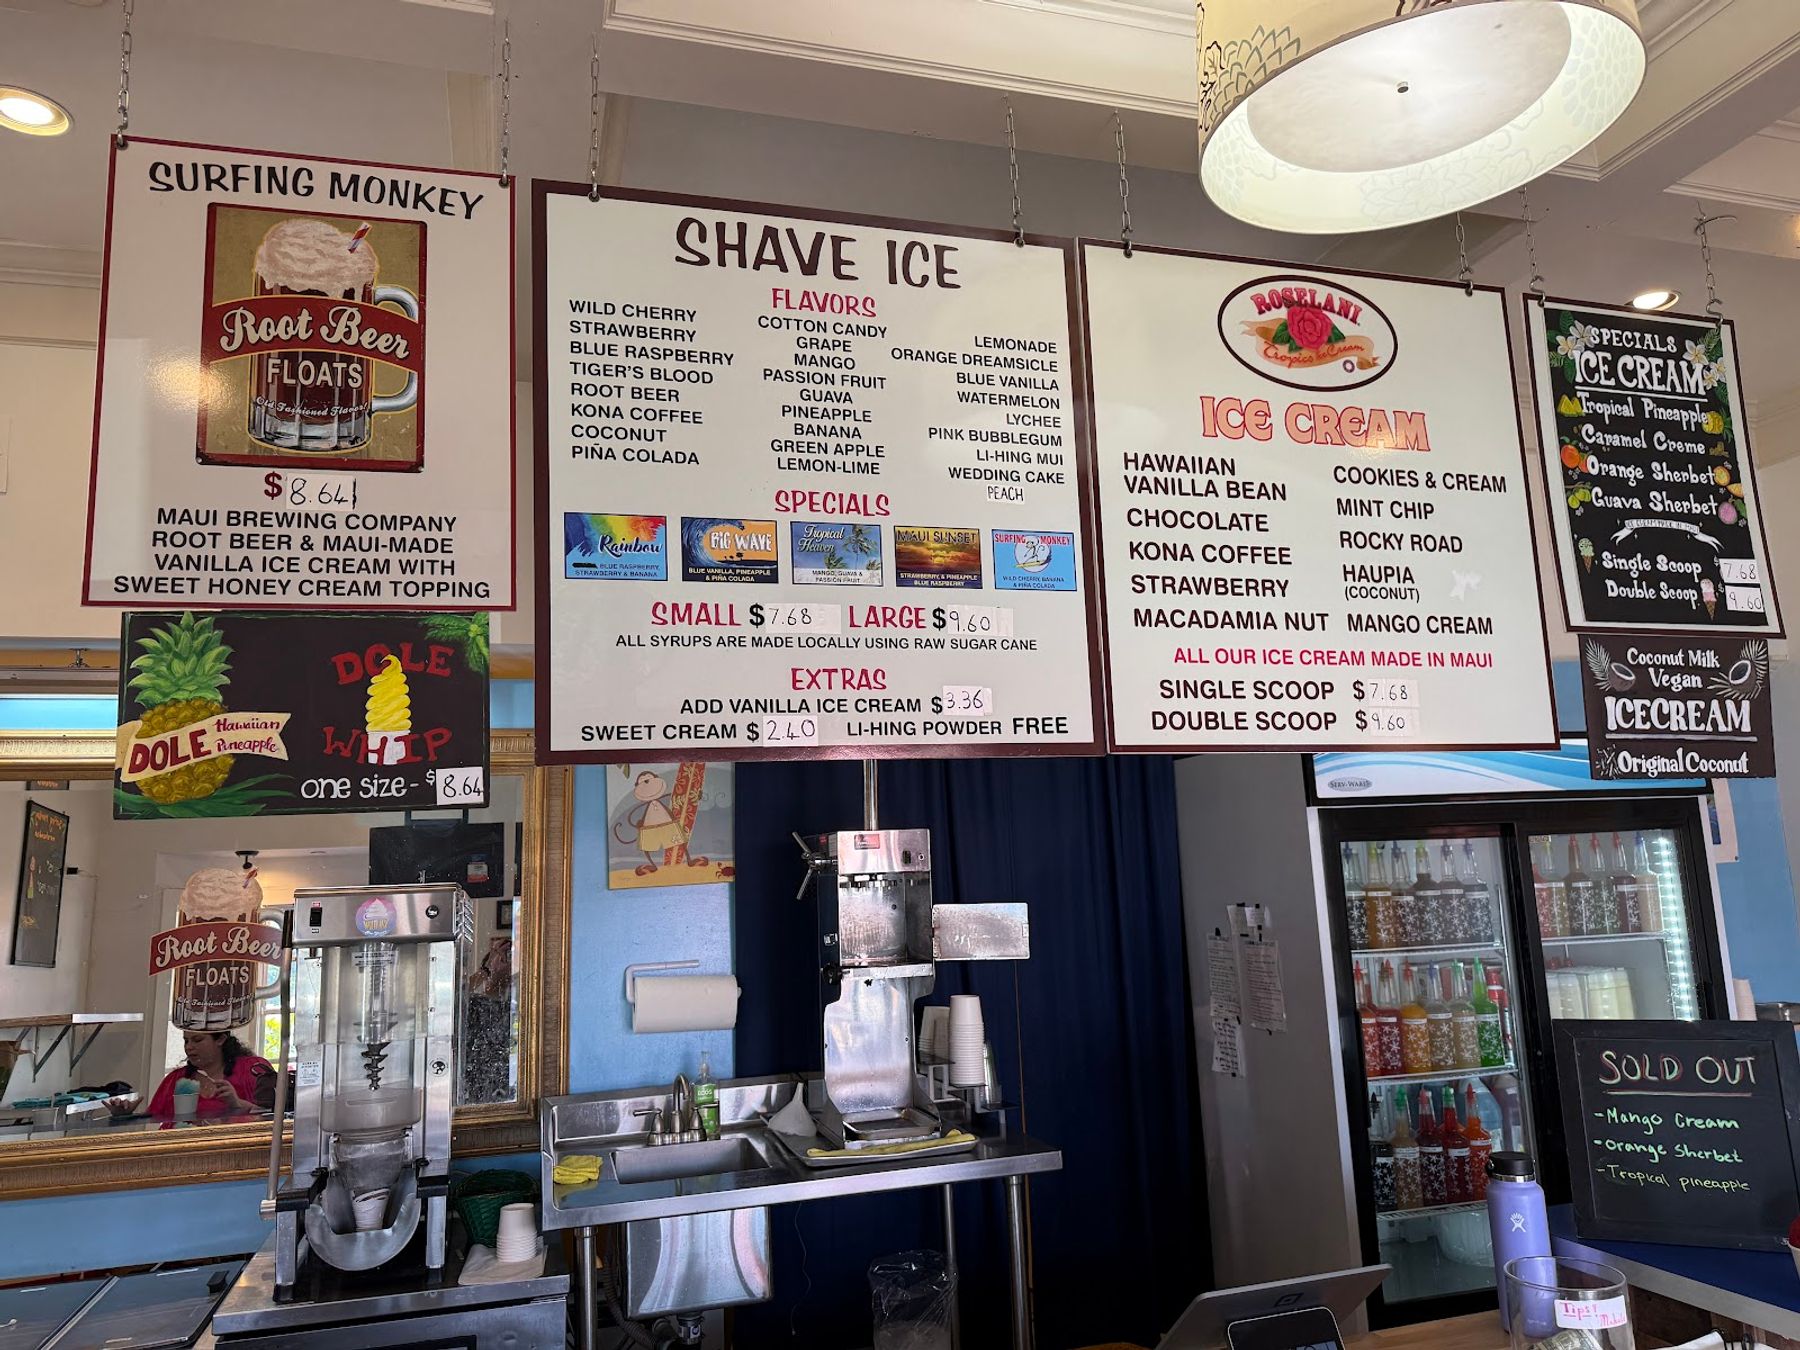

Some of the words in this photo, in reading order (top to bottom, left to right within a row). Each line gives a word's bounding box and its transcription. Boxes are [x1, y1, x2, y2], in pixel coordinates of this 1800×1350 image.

[148, 161, 314, 197] SURFING
[329, 172, 484, 220] MONKEY
[675, 217, 859, 281] SHAVE
[886, 238, 961, 290] ICE
[569, 300, 618, 318] WILD
[622, 303, 696, 323] CHERRY
[771, 287, 876, 318] FLAVORS
[219, 308, 314, 352] Root
[320, 306, 410, 359] Beer
[757, 315, 829, 334] COTTON
[832, 320, 887, 340] CANDY
[974, 335, 1057, 354] LEMONADE
[1326, 343, 1364, 356] Cream
[1589, 327, 1678, 353] SPECIALS
[794, 352, 855, 370] MANGO
[1574, 350, 1615, 386] ICE
[1617, 354, 1707, 395] CREAM
[267, 358, 364, 389] FLOATS
[570, 362, 645, 381] TIGER'S
[649, 365, 714, 385] BLOOD
[956, 372, 996, 388] BLUE
[999, 374, 1059, 391] VANILLA
[800, 389, 853, 404] GUAVA
[571, 404, 626, 421] KONA
[629, 407, 703, 425] COFFEE
[1006, 413, 1062, 428] LYCHEE
[1576, 391, 1635, 424] Tropical
[1641, 400, 1709, 432] Pineapple
[794, 423, 861, 440] BANANA
[1199, 395, 1273, 441] ICE
[1285, 401, 1431, 452] CREAM
[1581, 424, 1647, 449] Caramel
[1653, 431, 1705, 455] Creme
[571, 444, 618, 462] PIÑA
[622, 447, 700, 465] COLADA
[776, 457, 880, 475] LEMON-LIME
[977, 449, 1032, 464] LI-HING
[1036, 451, 1064, 467] MUI
[1123, 452, 1235, 476] HAWAIIAN
[1333, 465, 1418, 488] COOKIES
[1425, 470, 1437, 489] &
[1441, 472, 1507, 494] CREAM
[1586, 455, 1644, 486] Orange
[1650, 462, 1716, 485] Sherbet
[987, 486, 1024, 502] PEACH
[1123, 475, 1219, 499] VANILLA
[1226, 480, 1286, 501] BEAN
[775, 489, 891, 518] SPECIALS
[157, 507, 218, 527] MAUI
[226, 510, 337, 530] BREWING
[344, 514, 457, 532] COMPANY
[152, 531, 221, 550] ROOT
[229, 533, 291, 551] BEER
[299, 534, 314, 551] &
[323, 536, 453, 554] MAUI-MADE
[735, 532, 772, 551] WAVE
[804, 524, 844, 542] Tropical
[897, 530, 930, 543] MAUI
[934, 532, 977, 544] SUNSET
[994, 533, 1026, 544] SURFING
[1040, 536, 1071, 545] MONKEY
[1339, 531, 1403, 551] ROCKY
[1410, 534, 1462, 554] ROAD
[599, 535, 661, 558] Rainbow
[799, 538, 834, 553] Heaven
[1129, 541, 1194, 562] KONA
[1201, 544, 1292, 565] COFFEE
[1342, 564, 1414, 585] HAUPIA
[1602, 551, 1651, 578] Single
[1656, 554, 1702, 582] Scoop
[114, 576, 199, 594] SWEET
[208, 578, 291, 596] HONEY
[298, 579, 381, 597] CREAM
[389, 580, 490, 598] TOPPING
[1344, 586, 1420, 604] (COCONUT)
[1605, 579, 1656, 600] Double
[1659, 581, 1698, 609] Scoop
[651, 602, 741, 628] SMALL
[849, 605, 926, 630] LARGE
[1133, 608, 1277, 631] MACADAMIA
[1284, 611, 1329, 631] NUT
[1346, 613, 1420, 634] MANGO
[1426, 615, 1493, 635] CREAM
[616, 635, 646, 648] ALL
[650, 635, 713, 648] SYRUPS
[716, 636, 747, 648] ARE
[751, 636, 794, 649] MADE
[798, 636, 861, 649] LOCALLY
[864, 637, 910, 650] USING
[914, 638, 946, 650] RAW
[950, 639, 996, 651] SUGAR
[1001, 639, 1038, 651] CANE
[332, 642, 454, 685] DOLE
[1627, 647, 1684, 666] Coconut
[1687, 650, 1720, 668] Milk
[791, 667, 887, 691] EXTRAS
[1159, 679, 1246, 700] SINGLE
[1252, 680, 1334, 700] SCOOP
[1648, 667, 1702, 692] Vegan
[212, 715, 280, 732] Hawaiian
[1151, 711, 1249, 730] DOUBLE
[1255, 711, 1336, 730] SCOOP
[1605, 696, 1751, 732] ICECREAM
[581, 725, 657, 741] SWEET
[662, 724, 738, 740] CREAM
[847, 722, 918, 738] LI-HING
[922, 720, 1002, 737] POWDER
[1012, 717, 1068, 735] FREE
[128, 730, 210, 774] DOLE
[215, 736, 278, 754] Pineapple
[322, 726, 452, 765] WHIP
[1617, 748, 1685, 778] Original
[1686, 751, 1749, 773] Coconut
[301, 777, 351, 799] one
[156, 930, 217, 968] Root
[222, 926, 282, 960] Beer
[186, 966, 249, 986] FLOATS
[1599, 1050, 1683, 1084] SOLD
[1696, 1056, 1756, 1084] OUT
[1674, 1112, 1739, 1129] Cream
[1674, 1144, 1743, 1163] Sherbet
[1679, 1177, 1750, 1192] pineapple
